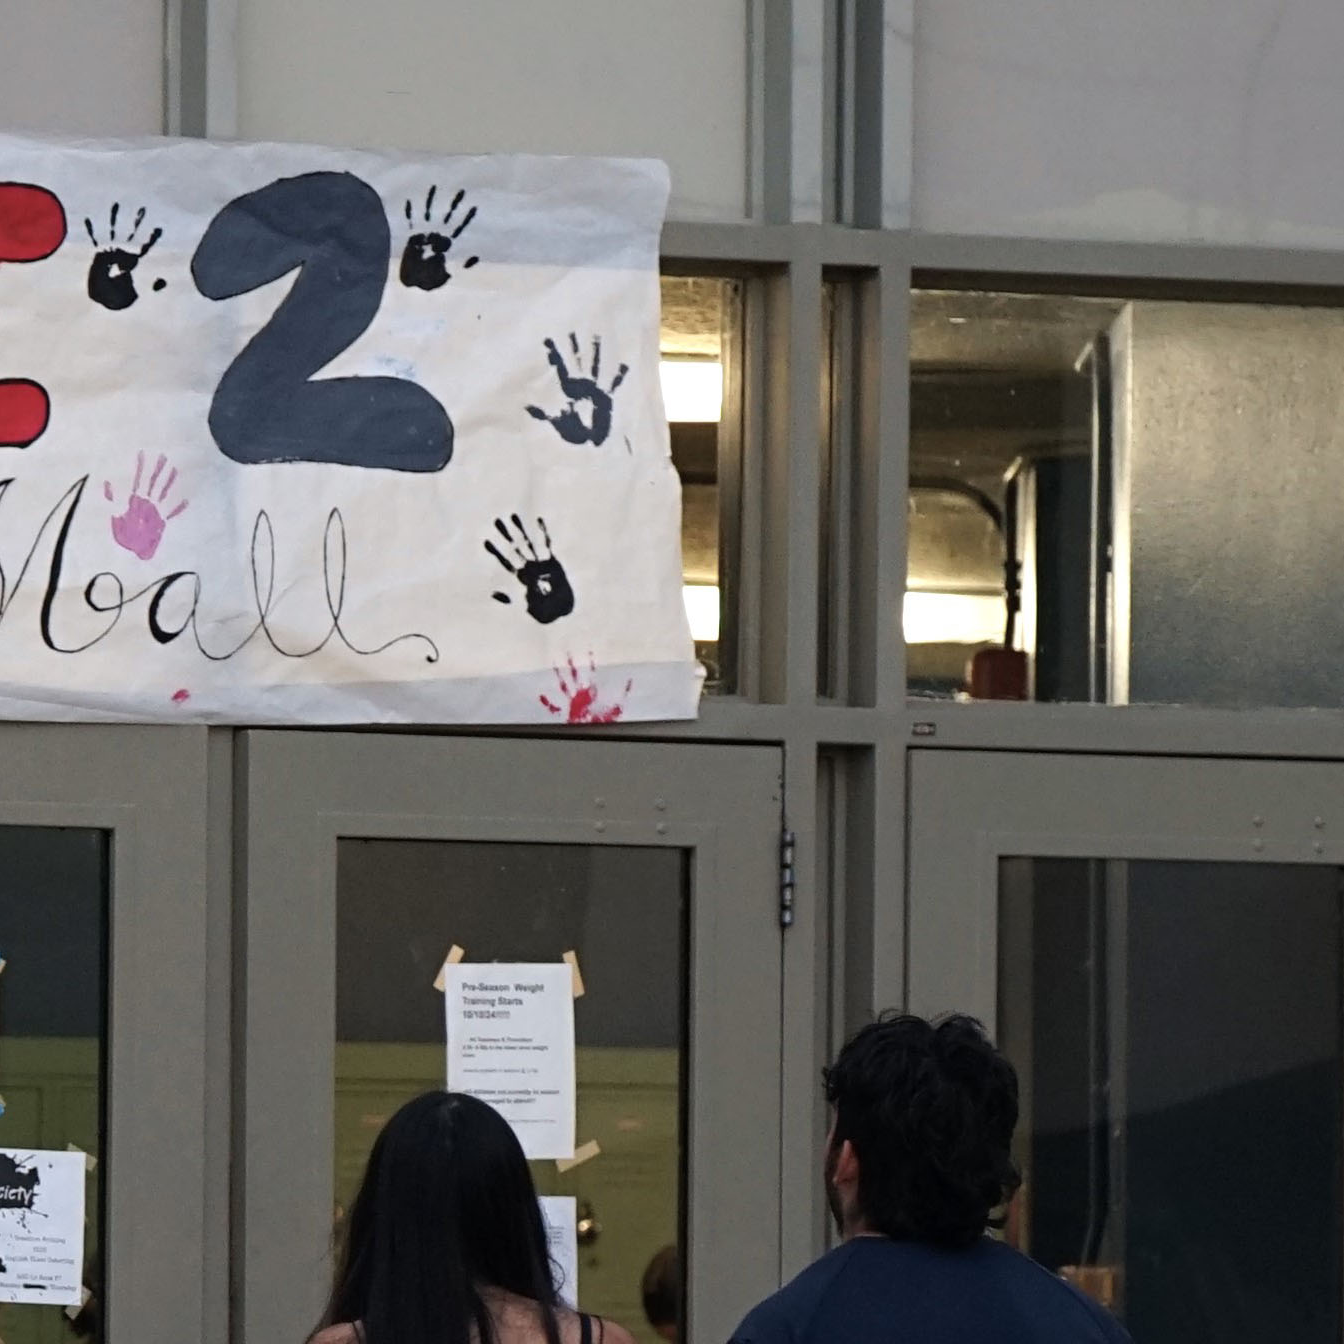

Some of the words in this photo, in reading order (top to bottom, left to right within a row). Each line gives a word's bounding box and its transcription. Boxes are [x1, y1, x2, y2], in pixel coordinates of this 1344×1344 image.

[190, 171, 454, 473] 2
[461, 982, 510, 992] Pre-Season
[513, 983, 544, 994] Weight
[462, 996, 496, 1007] Training
[497, 996, 523, 1006] Starts
